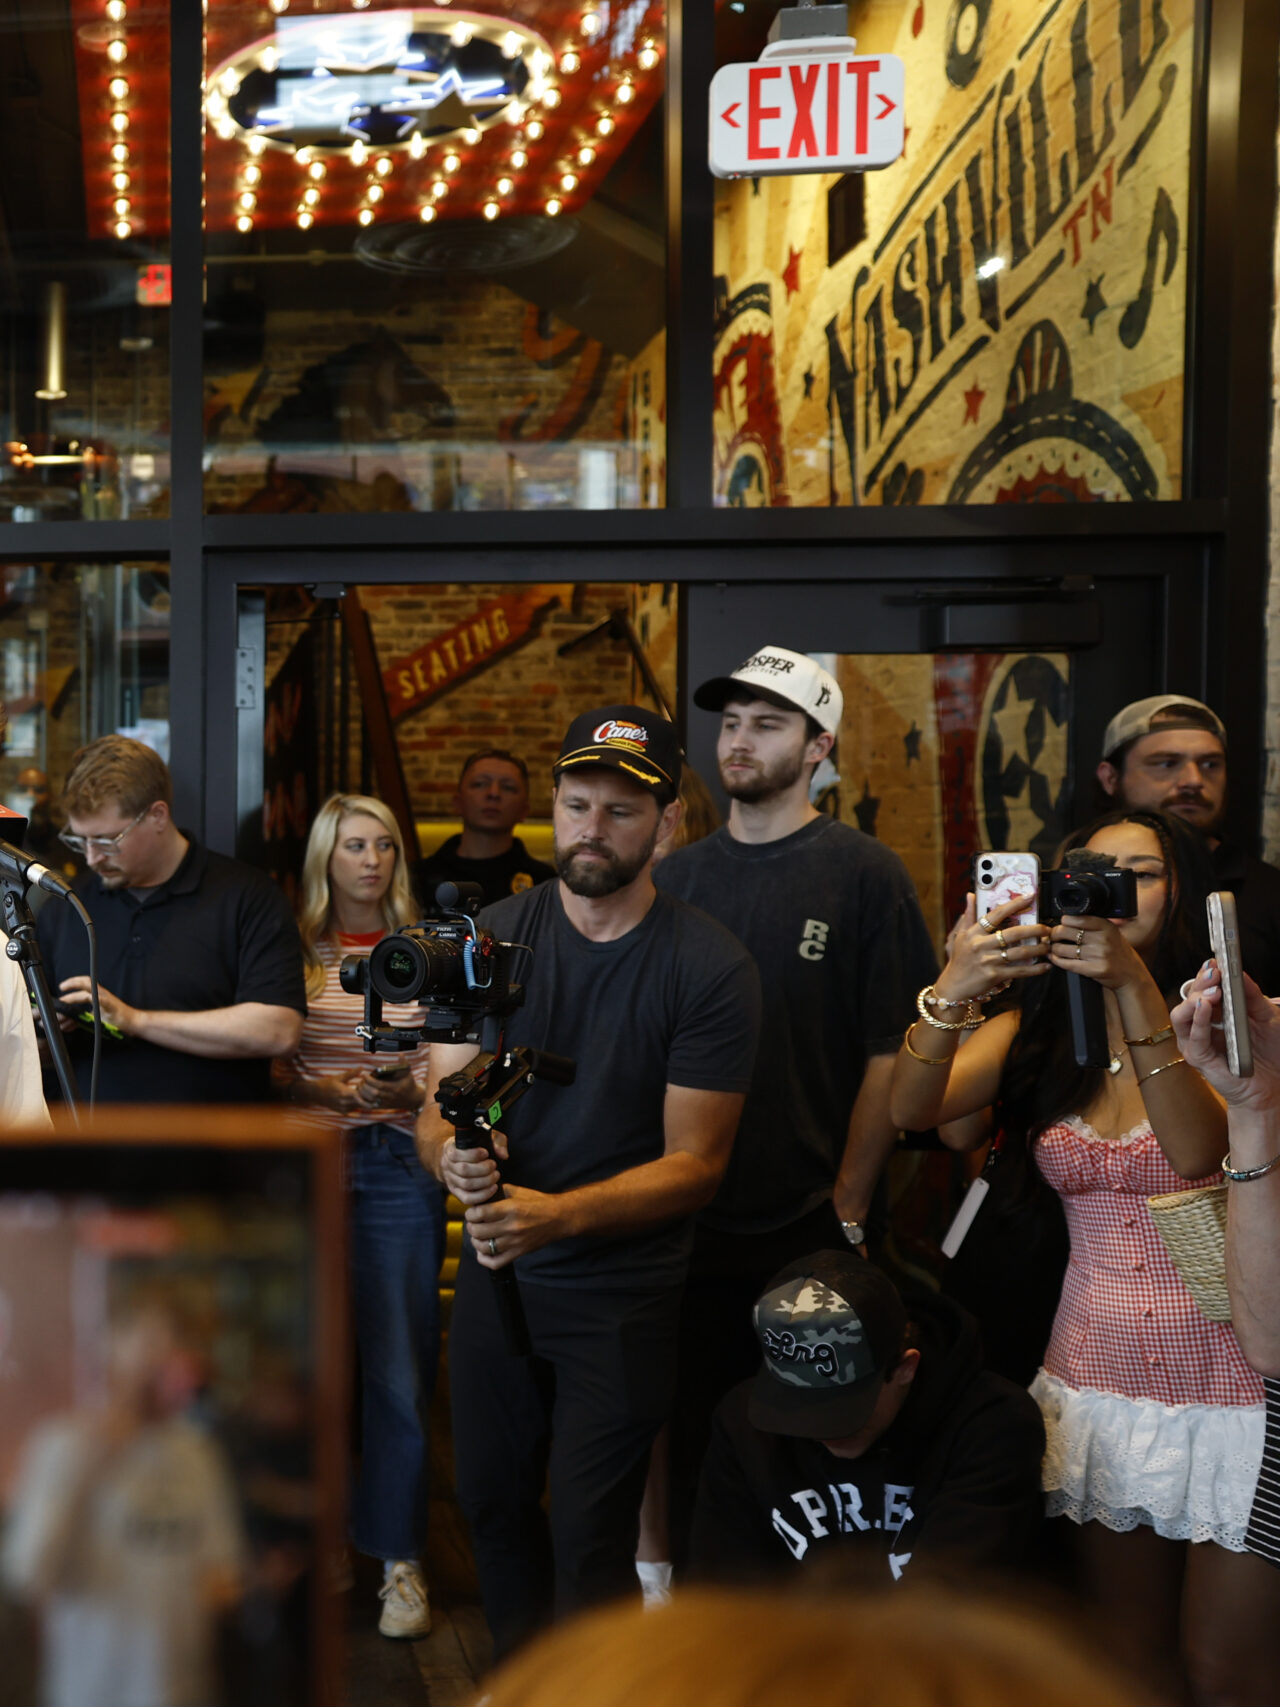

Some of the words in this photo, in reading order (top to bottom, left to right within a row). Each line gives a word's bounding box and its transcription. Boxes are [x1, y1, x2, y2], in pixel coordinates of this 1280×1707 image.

[746, 60, 881, 161] EXIT
[1061, 156, 1116, 268] TN
[397, 606, 511, 700] SEATING
[593, 720, 649, 743] Cane's
